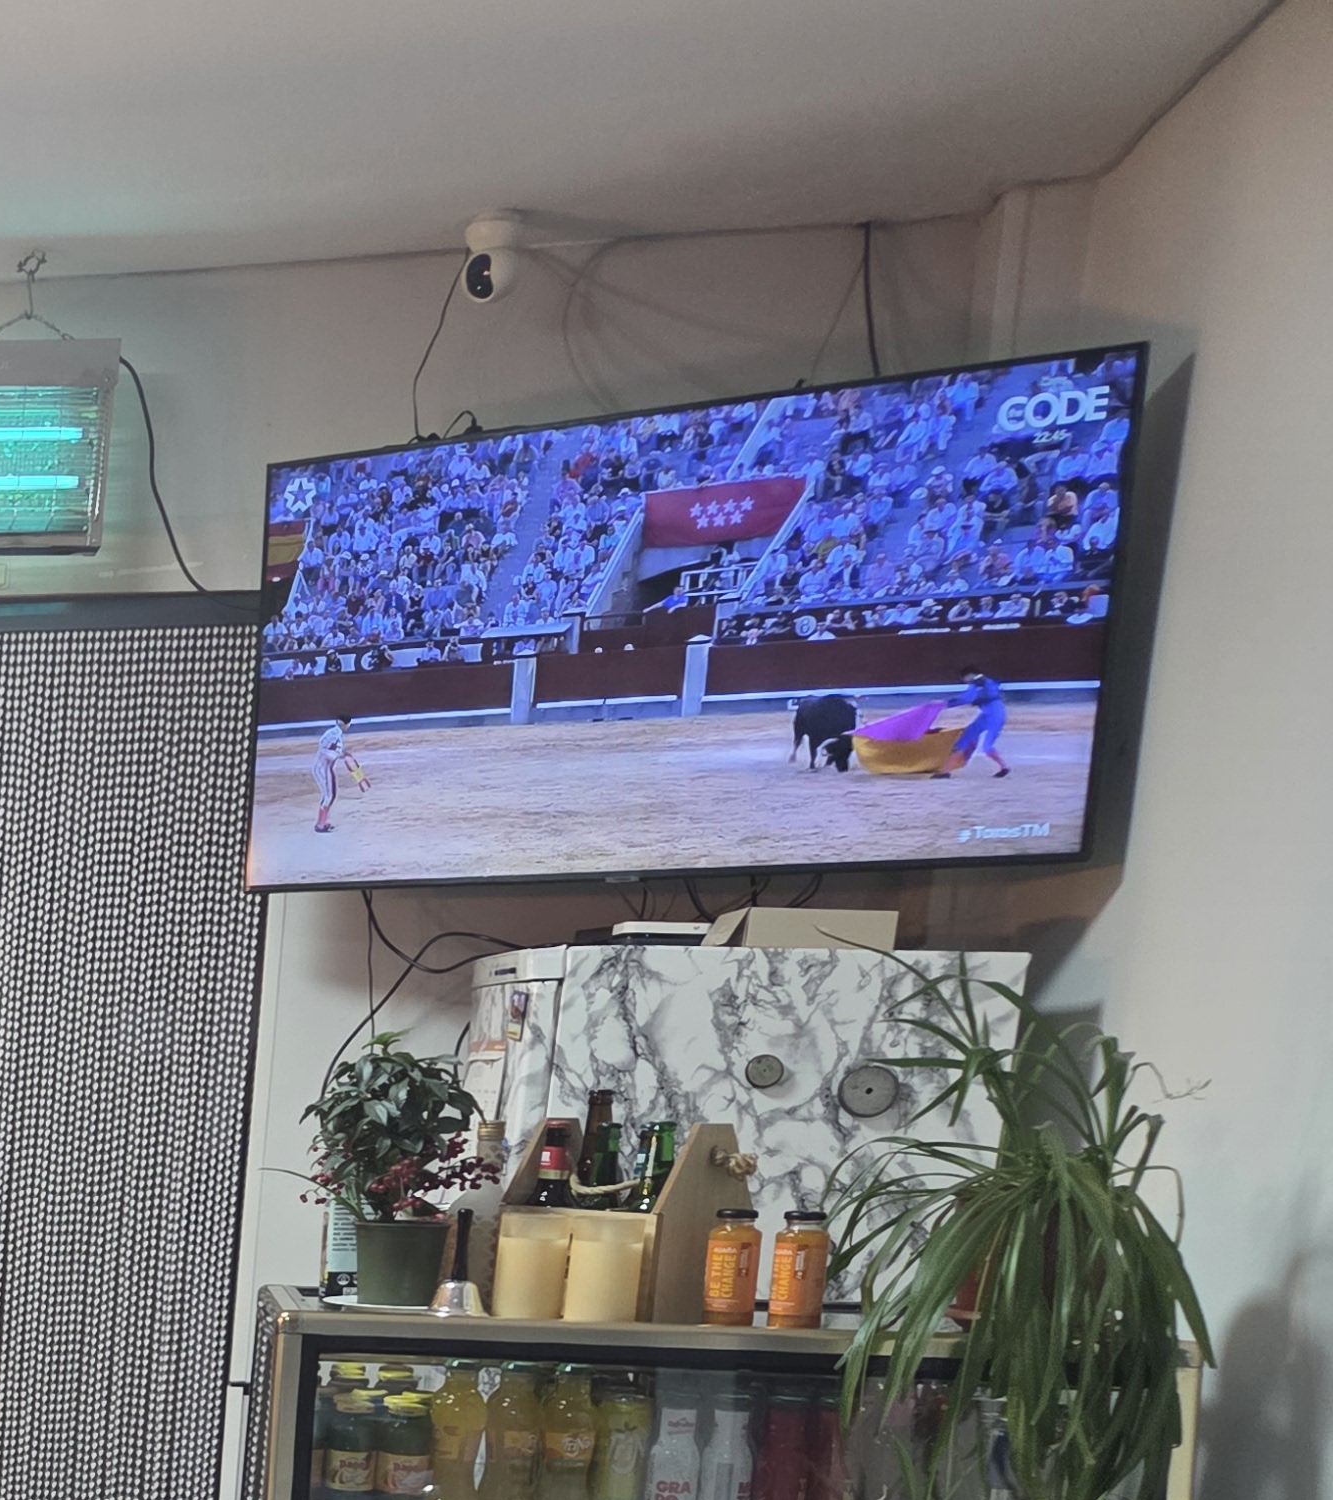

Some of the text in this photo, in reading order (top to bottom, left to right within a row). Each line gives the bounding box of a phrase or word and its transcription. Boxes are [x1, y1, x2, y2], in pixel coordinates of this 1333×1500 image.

[997, 385, 1110, 432] CODE
[955, 822, 1051, 844] #TorosTM
[709, 1253, 723, 1297] BE THE
[720, 1254, 737, 1298] CHANGE
[777, 1255, 793, 1300] CHANGE
[656, 1480, 691, 1494] GRA
